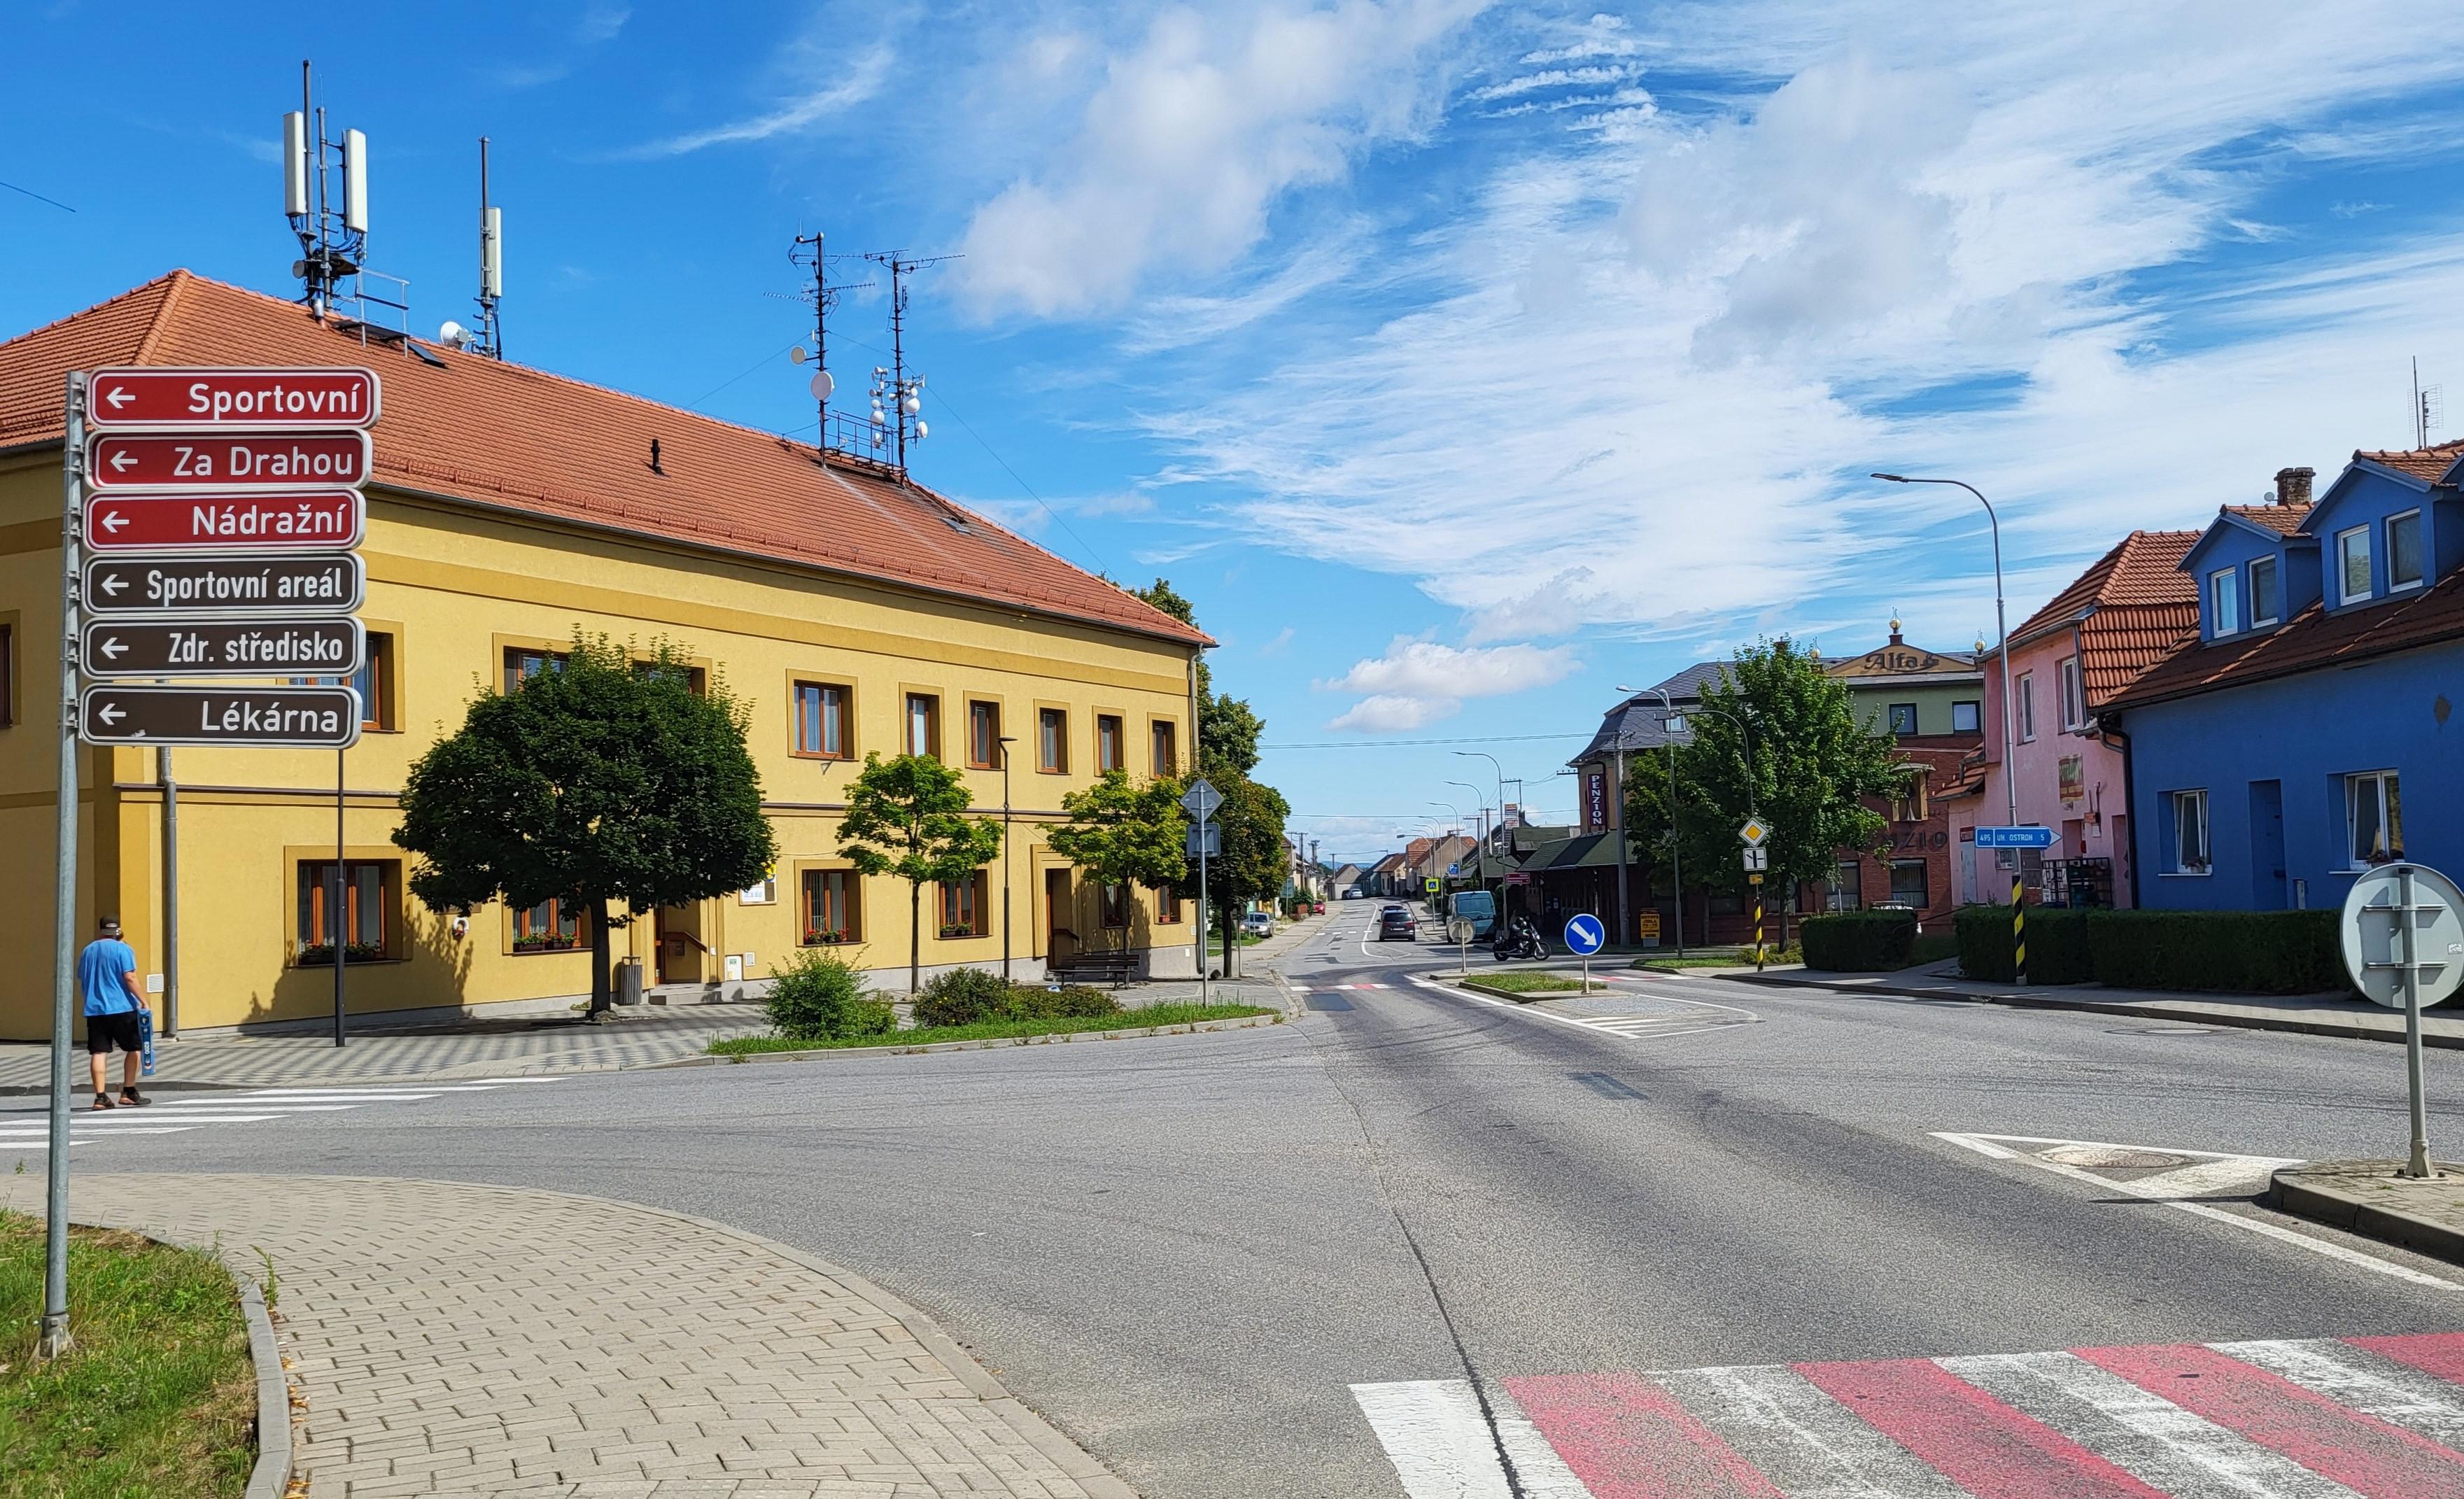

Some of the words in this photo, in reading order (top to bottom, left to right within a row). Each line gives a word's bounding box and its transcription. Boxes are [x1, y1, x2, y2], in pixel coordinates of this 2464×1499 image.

[188, 383, 361, 420] Sportovní
[174, 447, 213, 477] Za
[230, 446, 353, 476] Drahou
[192, 503, 347, 535] Nádražní
[146, 568, 272, 607] Sportovní
[278, 568, 343, 598] areál
[168, 632, 214, 663] Zdr.
[225, 631, 343, 662] středisko
[1864, 652, 1918, 670] Alfa
[202, 701, 338, 733] Lékárna
[1591, 775, 1603, 824] PENZION
